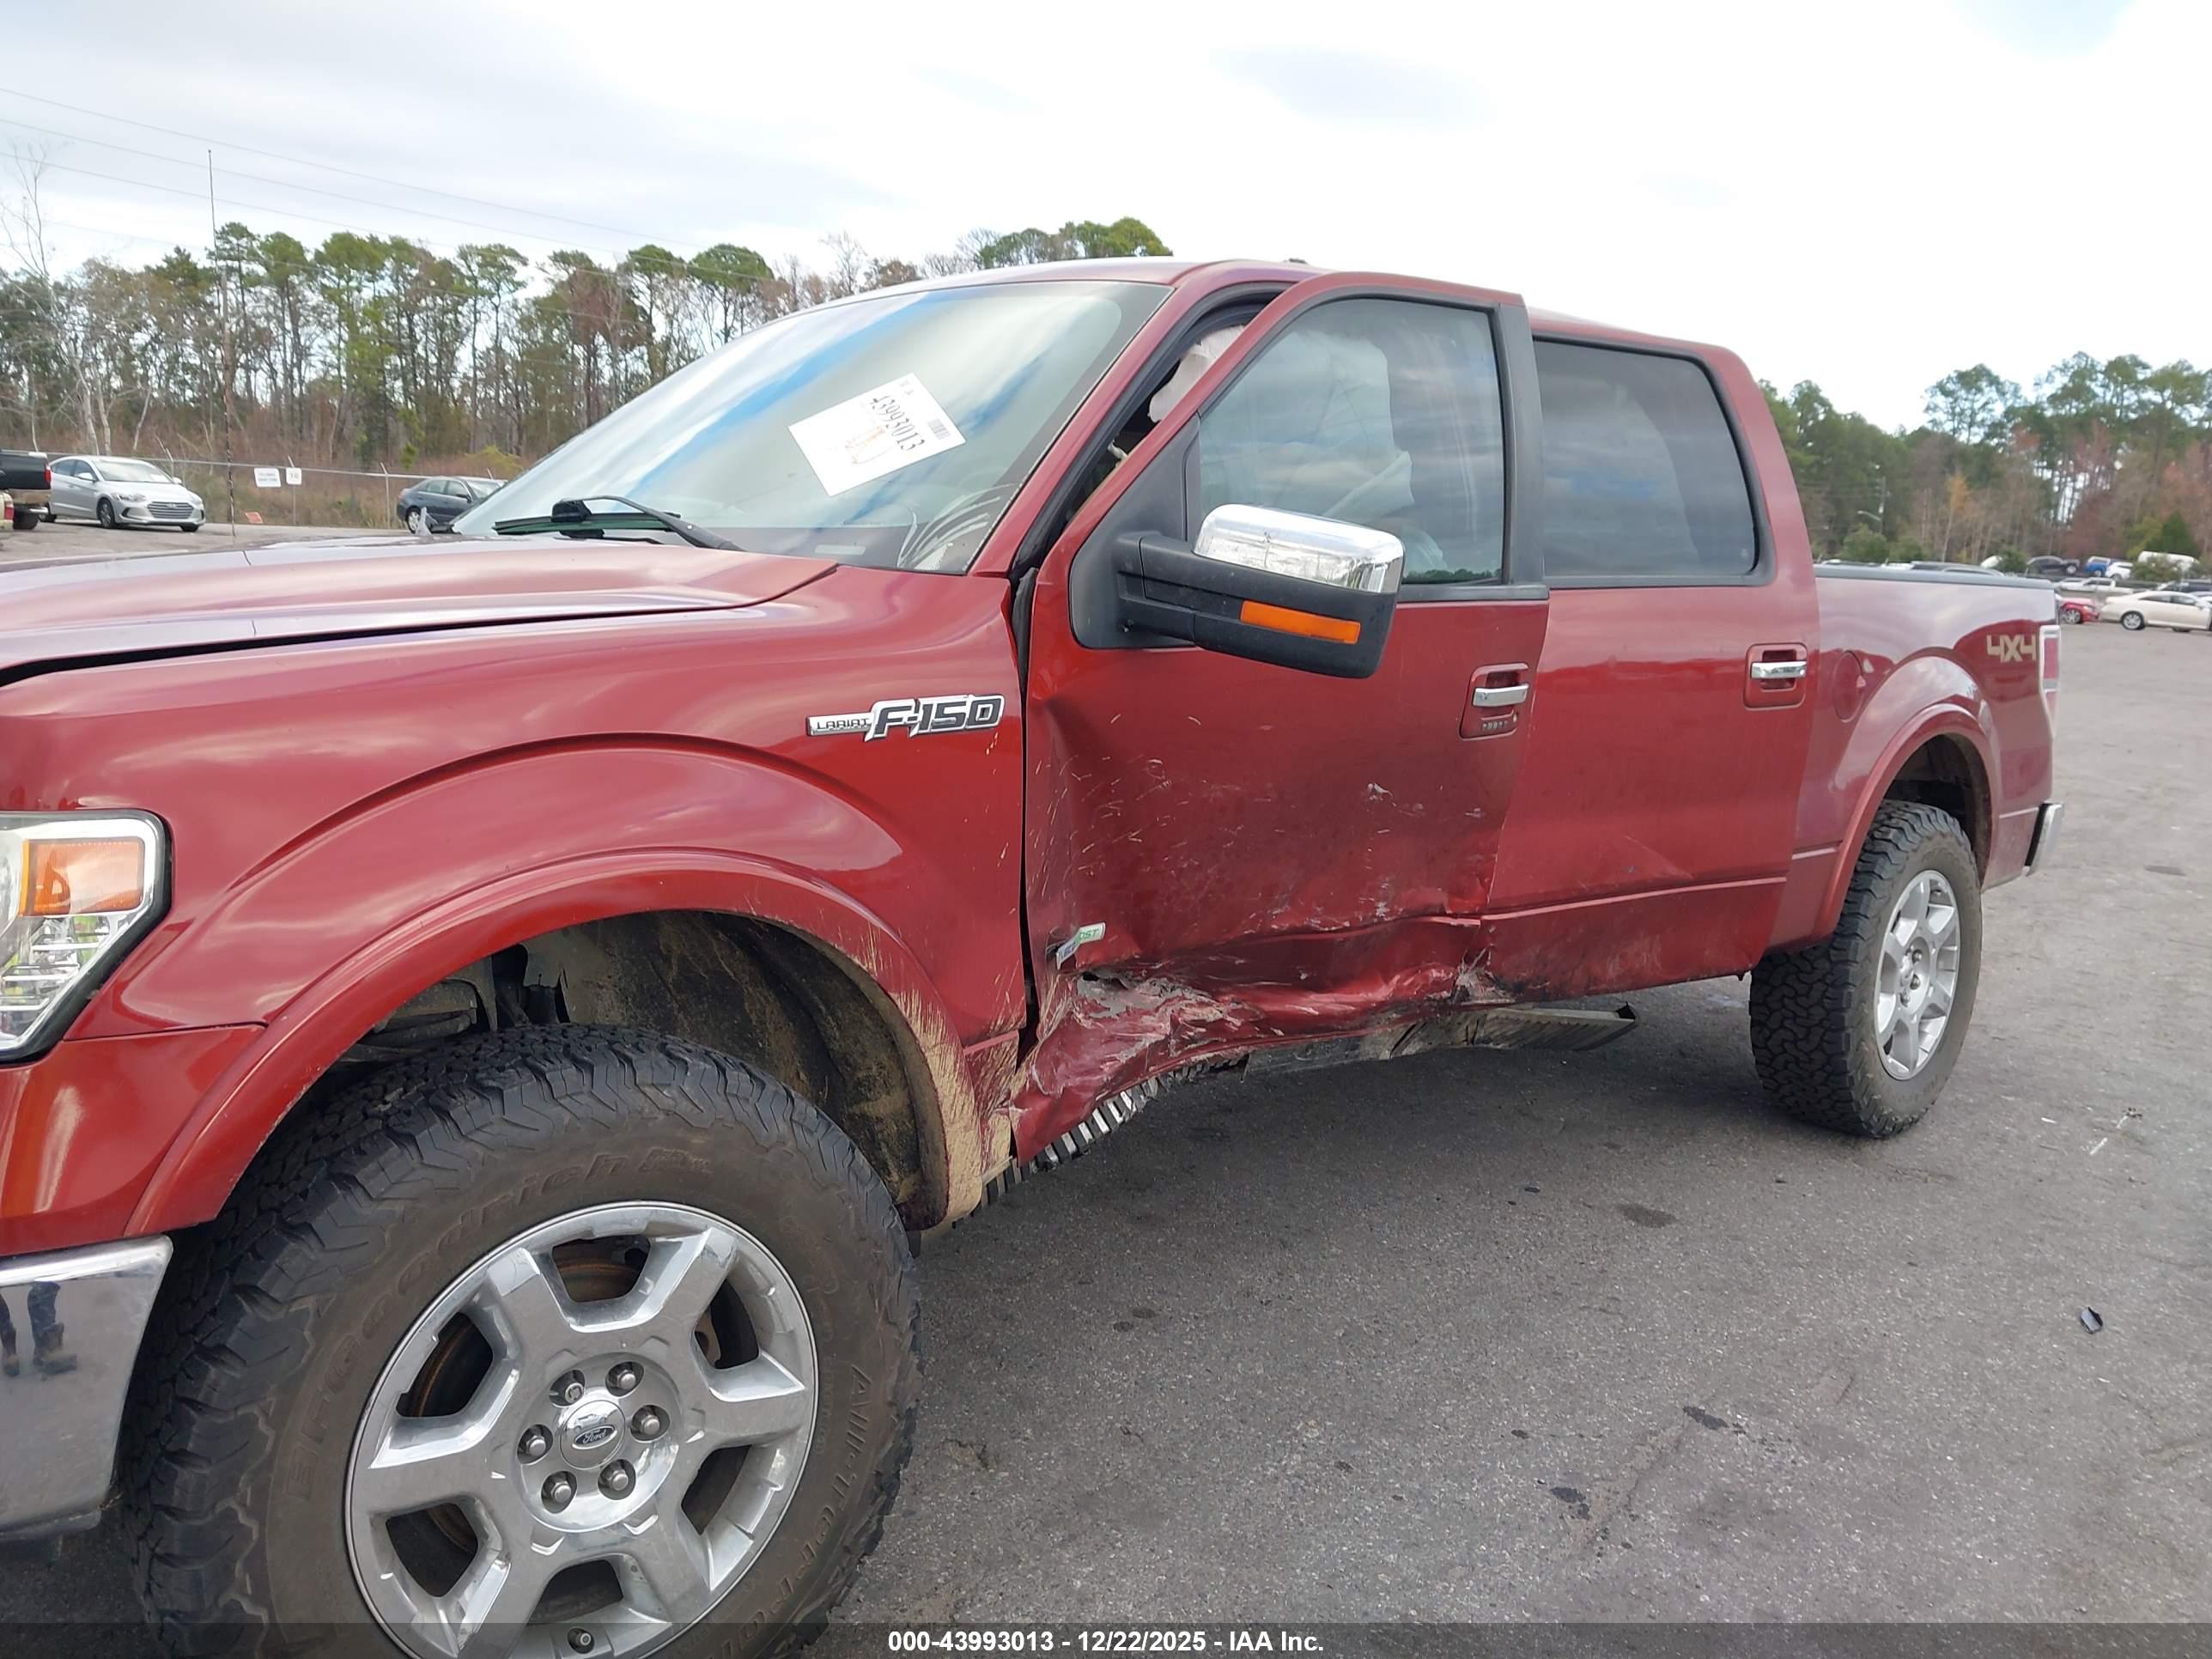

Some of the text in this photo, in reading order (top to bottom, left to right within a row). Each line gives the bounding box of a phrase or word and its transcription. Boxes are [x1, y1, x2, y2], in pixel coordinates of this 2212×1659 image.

[870, 395, 925, 451] 43993013
[817, 694, 1005, 742] LARIAT F-150
[582, 1427, 607, 1444] Ford
